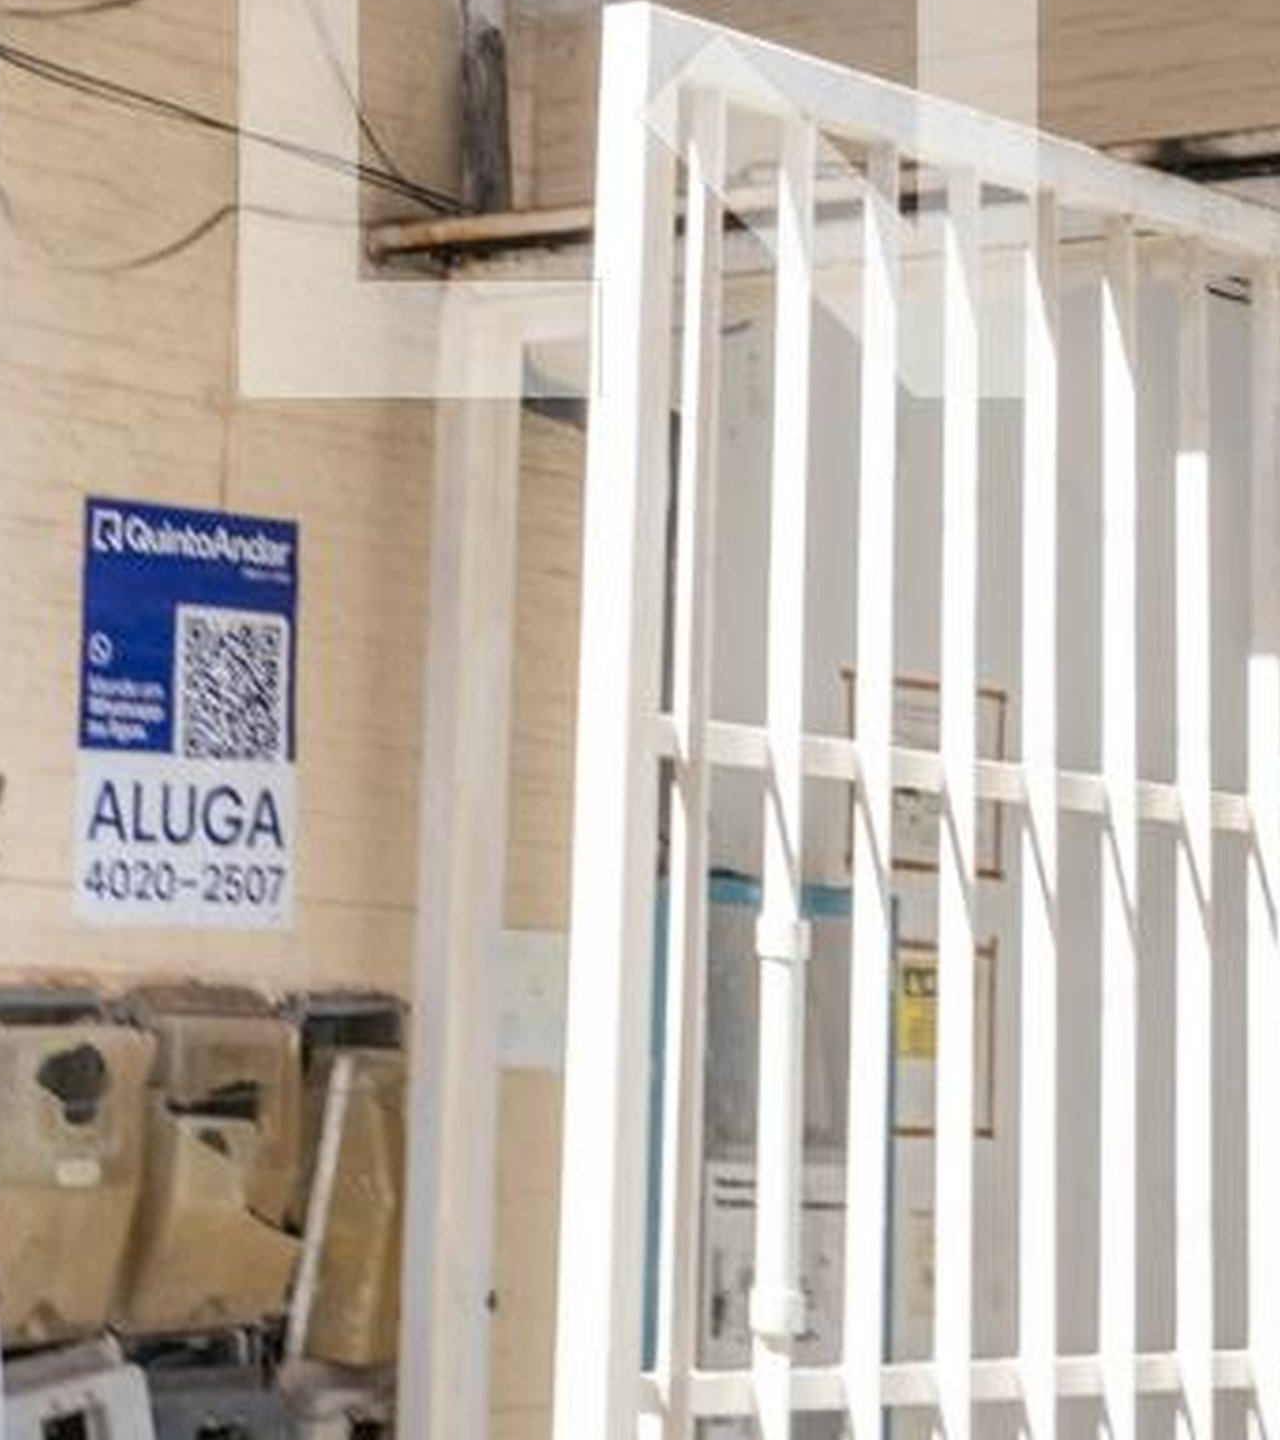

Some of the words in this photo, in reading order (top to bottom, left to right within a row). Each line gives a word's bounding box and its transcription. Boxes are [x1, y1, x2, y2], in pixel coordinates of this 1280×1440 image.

[126, 516, 291, 567] QuintoAndar
[86, 780, 285, 850] ALUGA
[85, 861, 286, 906] 4020-2507
